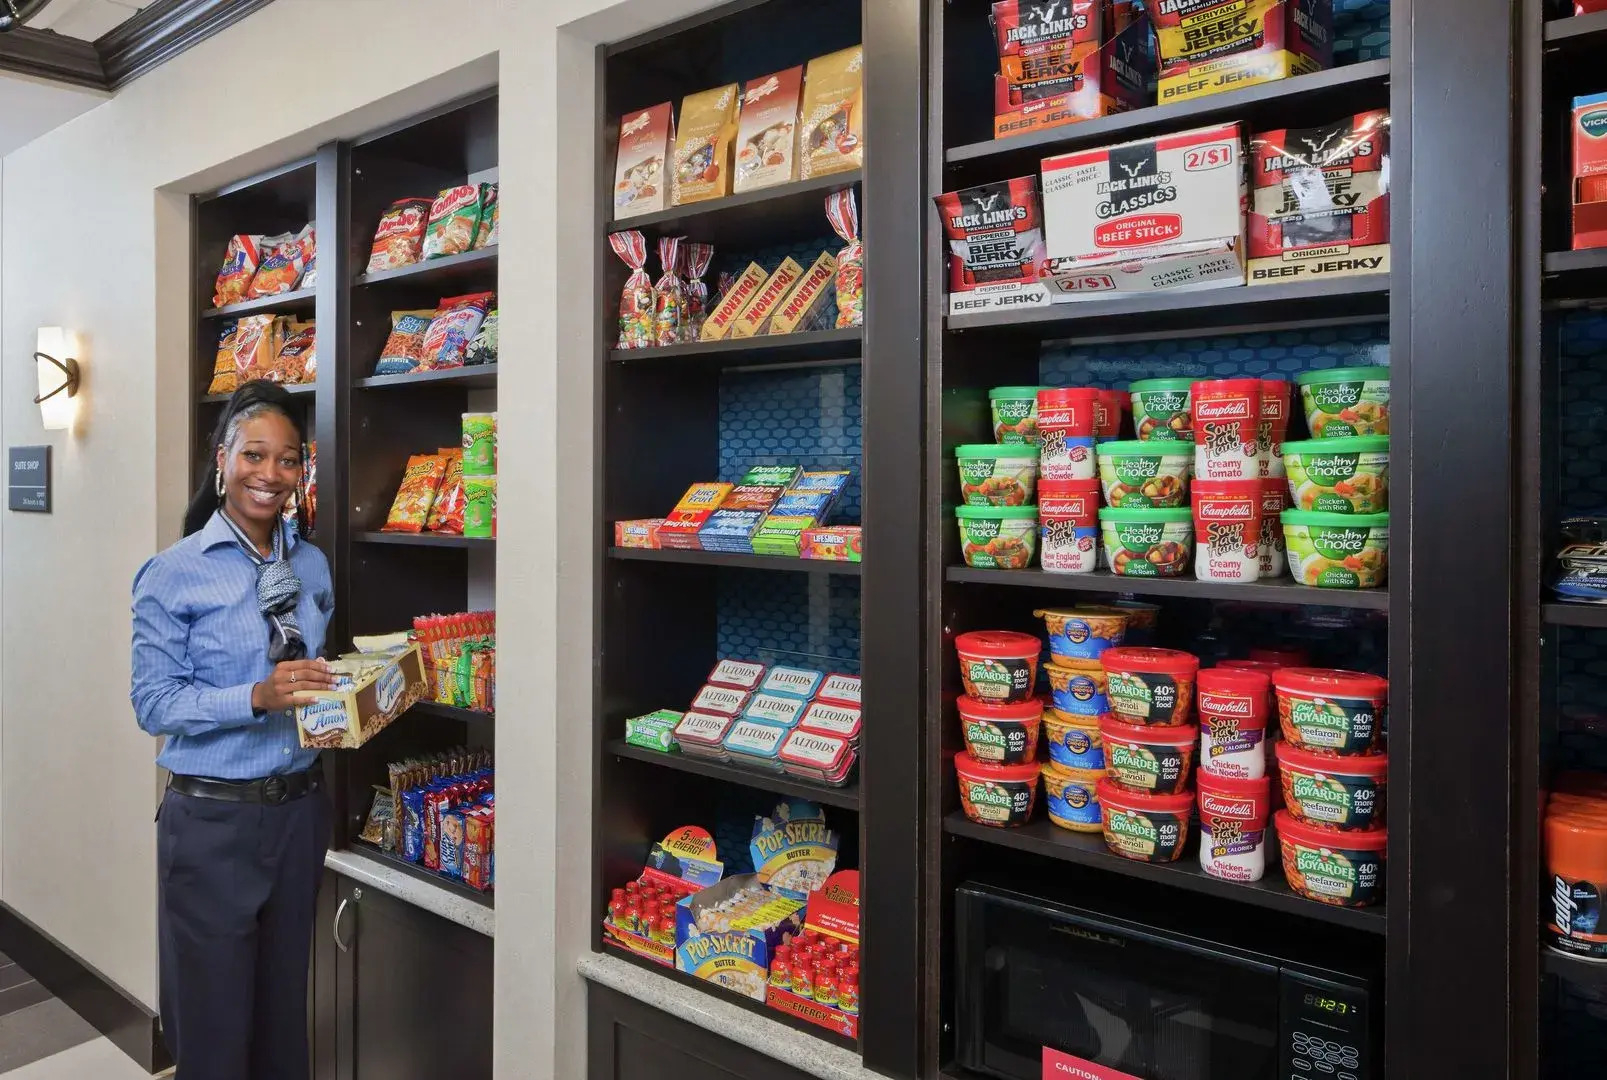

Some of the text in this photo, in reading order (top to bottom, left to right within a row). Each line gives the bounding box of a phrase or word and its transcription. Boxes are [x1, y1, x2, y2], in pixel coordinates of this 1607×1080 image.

[1191, 4, 1237, 23] TERIYAKI
[1007, 15, 1088, 42] JACK LINK'S
[1184, 12, 1248, 41] BEEF
[1180, 18, 1258, 53] JERKY
[1022, 53, 1071, 70] BEEF
[1016, 62, 1079, 82] JERKY
[1187, 147, 1229, 168] 2/$1
[1097, 171, 1172, 195] JACK LINK'S
[952, 206, 1027, 228] JACK LINK'S
[1116, 218, 1157, 230] ORIGINAL
[971, 231, 1010, 241] PEPPERED
[1103, 225, 1173, 242] BEEF STICK
[969, 241, 1016, 255] BEEF
[1291, 247, 1341, 258] ORIGINAL
[967, 248, 1025, 264] JERKY
[1151, 267, 1192, 281] CLASSIC
[1253, 256, 1383, 280] BEEF JERKY
[1061, 276, 1111, 291] 2/$1
[1153, 273, 1195, 288] CLASSIC
[783, 264, 831, 322] TOBLERONE
[979, 284, 1017, 292] PEPPERED
[713, 273, 759, 329] TOBLERONE
[745, 269, 794, 326] TOBLERONE
[954, 293, 1045, 310] BEEF JERKY
[1148, 393, 1184, 405] Healthy
[1315, 394, 1356, 405] Choice
[1318, 386, 1360, 401] Healthy
[1001, 399, 1031, 412] Healthy
[1144, 401, 1181, 412] Choice
[1199, 402, 1246, 416] Campbell's
[999, 408, 1029, 418] Choice
[1203, 421, 1241, 436] Soup
[1326, 424, 1350, 432] Chicken
[14, 460, 40, 470] SUITE SHOP
[750, 466, 796, 474] Dentyne
[964, 459, 995, 472] Healthy
[1121, 460, 1158, 472] Healthy
[1207, 458, 1242, 470] Creamy
[1310, 458, 1356, 471] Healthy
[963, 468, 992, 478] Choice
[1116, 467, 1156, 477] Choice
[1208, 469, 1242, 478] Tomato
[1306, 466, 1354, 476] Choice
[1041, 502, 1081, 514] Campbell's
[1318, 498, 1344, 506] Chicken
[713, 510, 761, 518] Dentyne
[1201, 502, 1250, 516] Campbell's
[760, 528, 800, 536] DOUBLEMINT
[969, 520, 1000, 532] Healthy
[1046, 518, 1075, 533] Soup
[1124, 526, 1162, 538] Healthy
[1206, 522, 1244, 537] Soup
[966, 529, 998, 538] Choice
[1120, 534, 1159, 544] Choice
[1320, 531, 1367, 546] Healthy
[1314, 539, 1362, 550] Choice
[1209, 559, 1242, 572] Creamy
[1209, 569, 1242, 578] Tomato
[1326, 572, 1352, 580] Chicken
[720, 665, 756, 678] ALTOIDS
[970, 671, 1012, 684] BOYARDEE
[1013, 670, 1028, 678] 40%
[772, 672, 812, 686] ALTOIDS
[828, 680, 861, 693] ALTOI
[1109, 684, 1151, 700] BOYARDEE
[1154, 686, 1174, 696] 40%
[702, 690, 740, 704] ALTOIDS
[756, 699, 796, 713] ALTOIDS
[1156, 700, 1173, 708] food
[1202, 698, 1248, 713] Campbell's
[1297, 704, 1312, 714] Chef
[300, 700, 344, 722] Famous
[811, 708, 854, 722] ALTOIDS
[311, 712, 344, 731] Amos
[686, 718, 721, 730] ALTOIDS
[1208, 716, 1240, 734] Soup
[1293, 710, 1350, 730] BOYARDEE
[1353, 714, 1374, 724] 40%
[736, 726, 778, 741] ALTOIDS
[968, 731, 1006, 746] BOYARDEE
[1008, 732, 1026, 740] 40%
[1300, 726, 1342, 738] beefaroni
[1354, 730, 1370, 738] food
[792, 736, 836, 754] ALTOIDS
[1112, 754, 1159, 772] BOYARDEE
[1162, 758, 1180, 767] 40%
[1212, 760, 1240, 770] Chicken
[1162, 766, 1179, 774] more
[1164, 772, 1178, 780] food
[1298, 777, 1312, 787] Chef
[970, 790, 1012, 806] BOYARDEE
[1014, 792, 1028, 801] 40%
[1294, 784, 1352, 806] BOYARDEE
[1354, 790, 1376, 800] 40%
[1204, 798, 1251, 814] Campbell's
[1301, 801, 1342, 814] beefaroni
[1356, 806, 1372, 814] food
[1110, 820, 1157, 839] BOYARDEE
[1160, 824, 1178, 834] 40%
[1212, 818, 1242, 834] Soup
[672, 841, 705, 856] ENERGY
[1160, 838, 1176, 846] food
[786, 849, 810, 860] BUTTER
[1302, 852, 1318, 862] Chef
[1214, 860, 1244, 872] Chicken
[1297, 858, 1356, 881] BOYARDEE
[1358, 864, 1378, 874] 40%
[1305, 874, 1348, 889] beefaroni
[1360, 879, 1376, 888] food
[1552, 876, 1577, 935] edge
[714, 960, 736, 968] BUTTER
[793, 1002, 827, 1021] ENERGY
[1320, 998, 1347, 1014] 1:27
